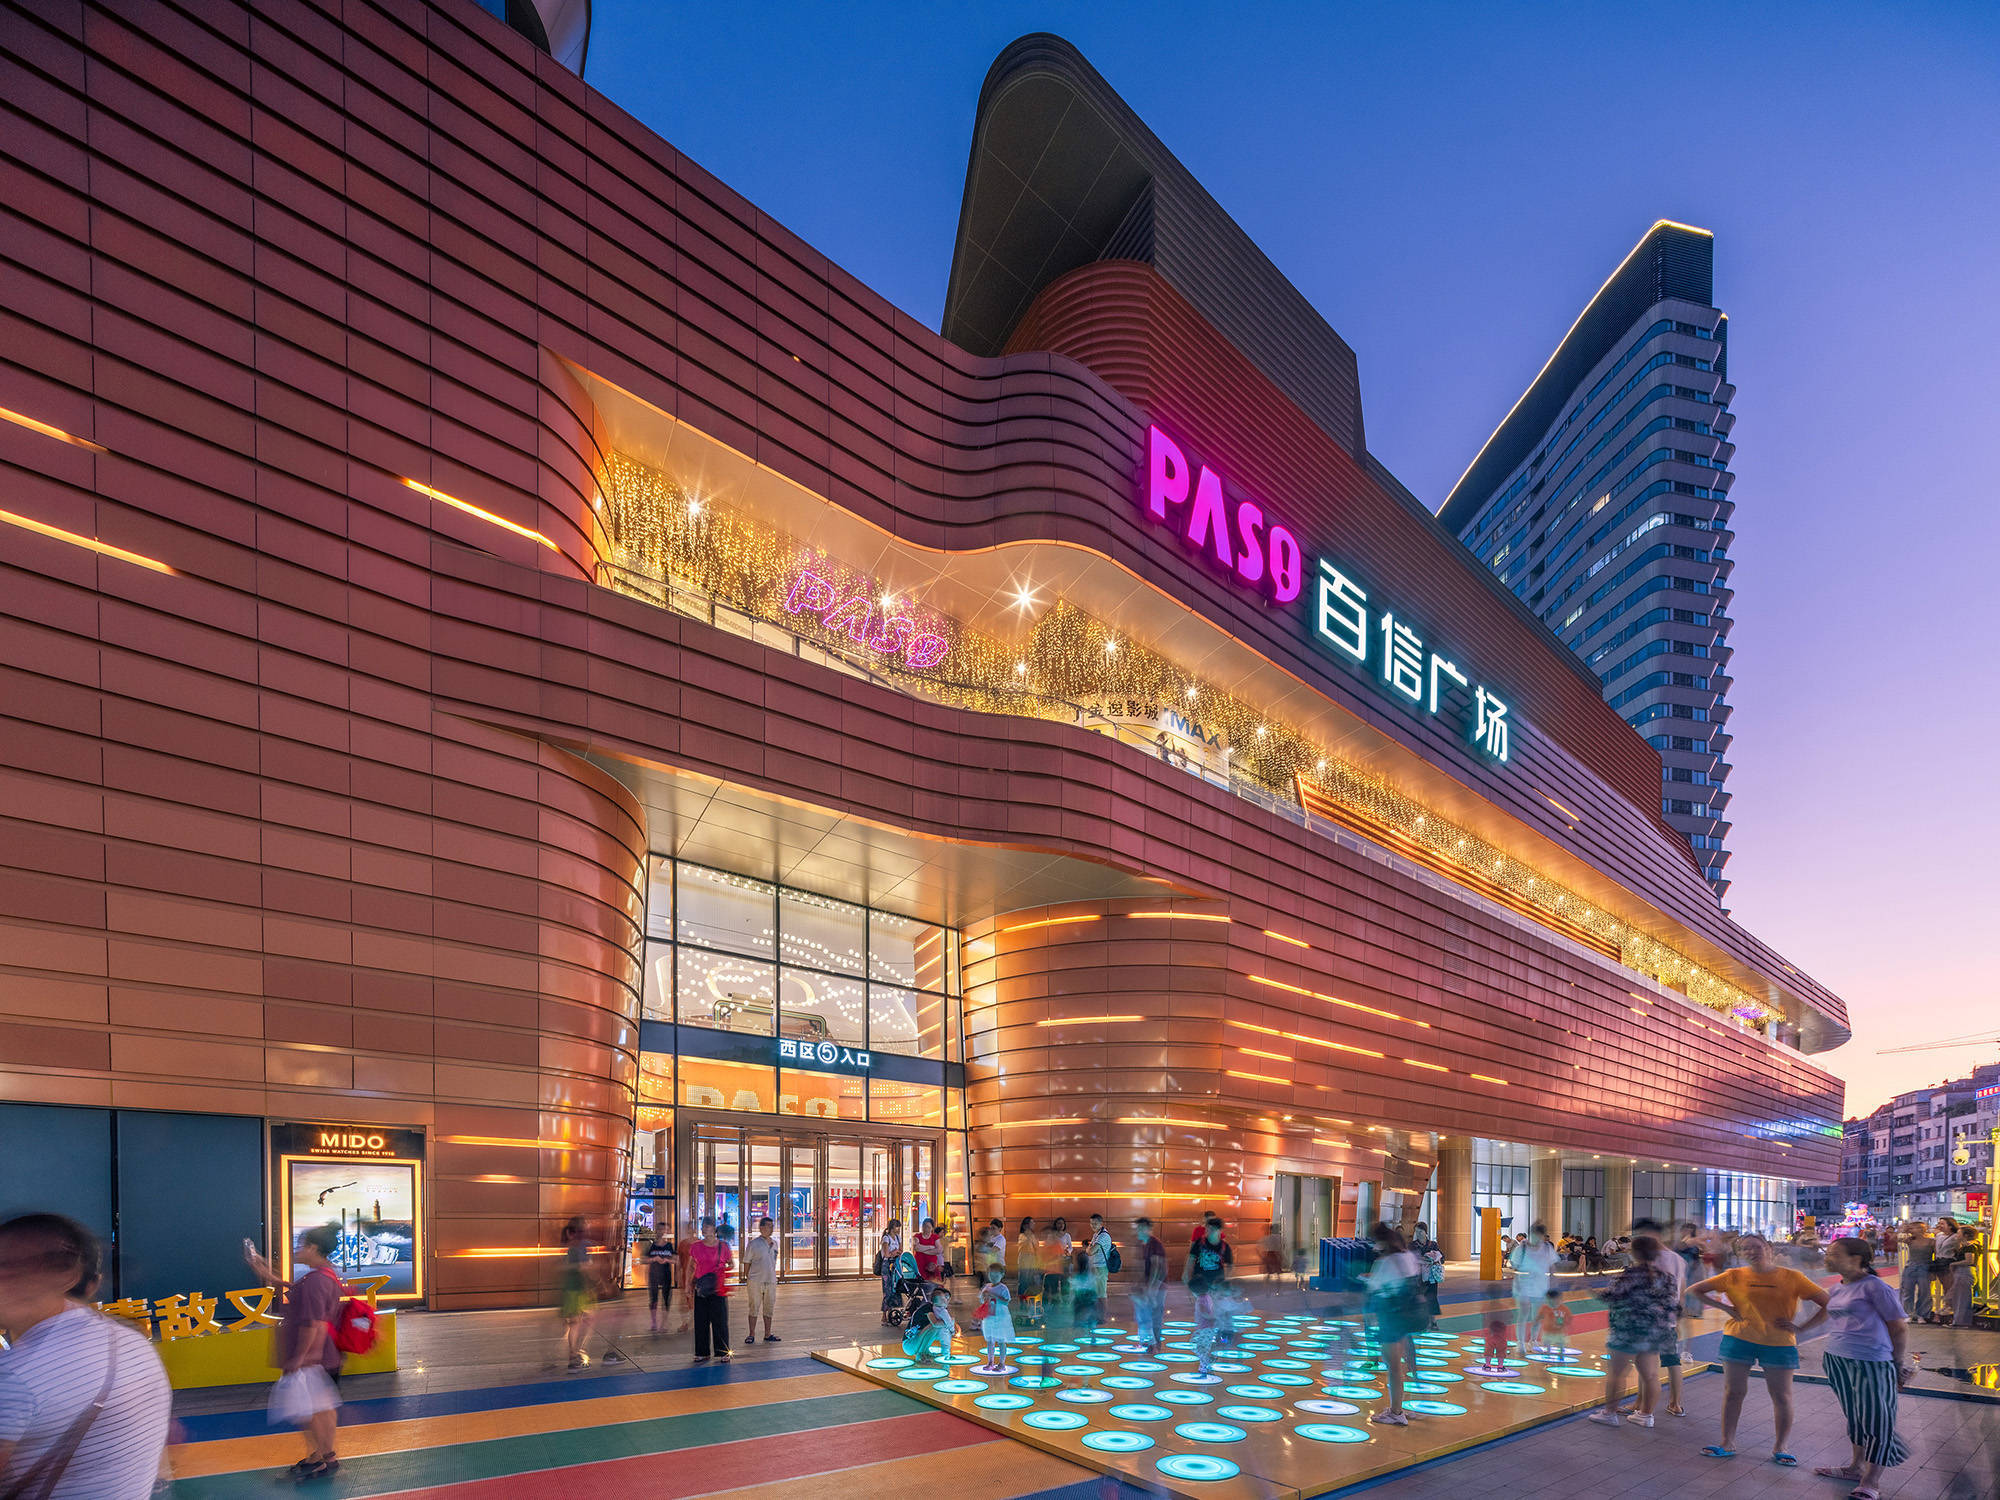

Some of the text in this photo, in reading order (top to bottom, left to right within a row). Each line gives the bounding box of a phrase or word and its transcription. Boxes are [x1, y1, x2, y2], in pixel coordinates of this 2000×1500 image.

[1148, 424, 1302, 603] PASO
[784, 570, 949, 668] PASO
[1318, 557, 1509, 764] 百信广场
[1163, 707, 1222, 750] IMAX
[320, 1133, 384, 1149] MIDO
